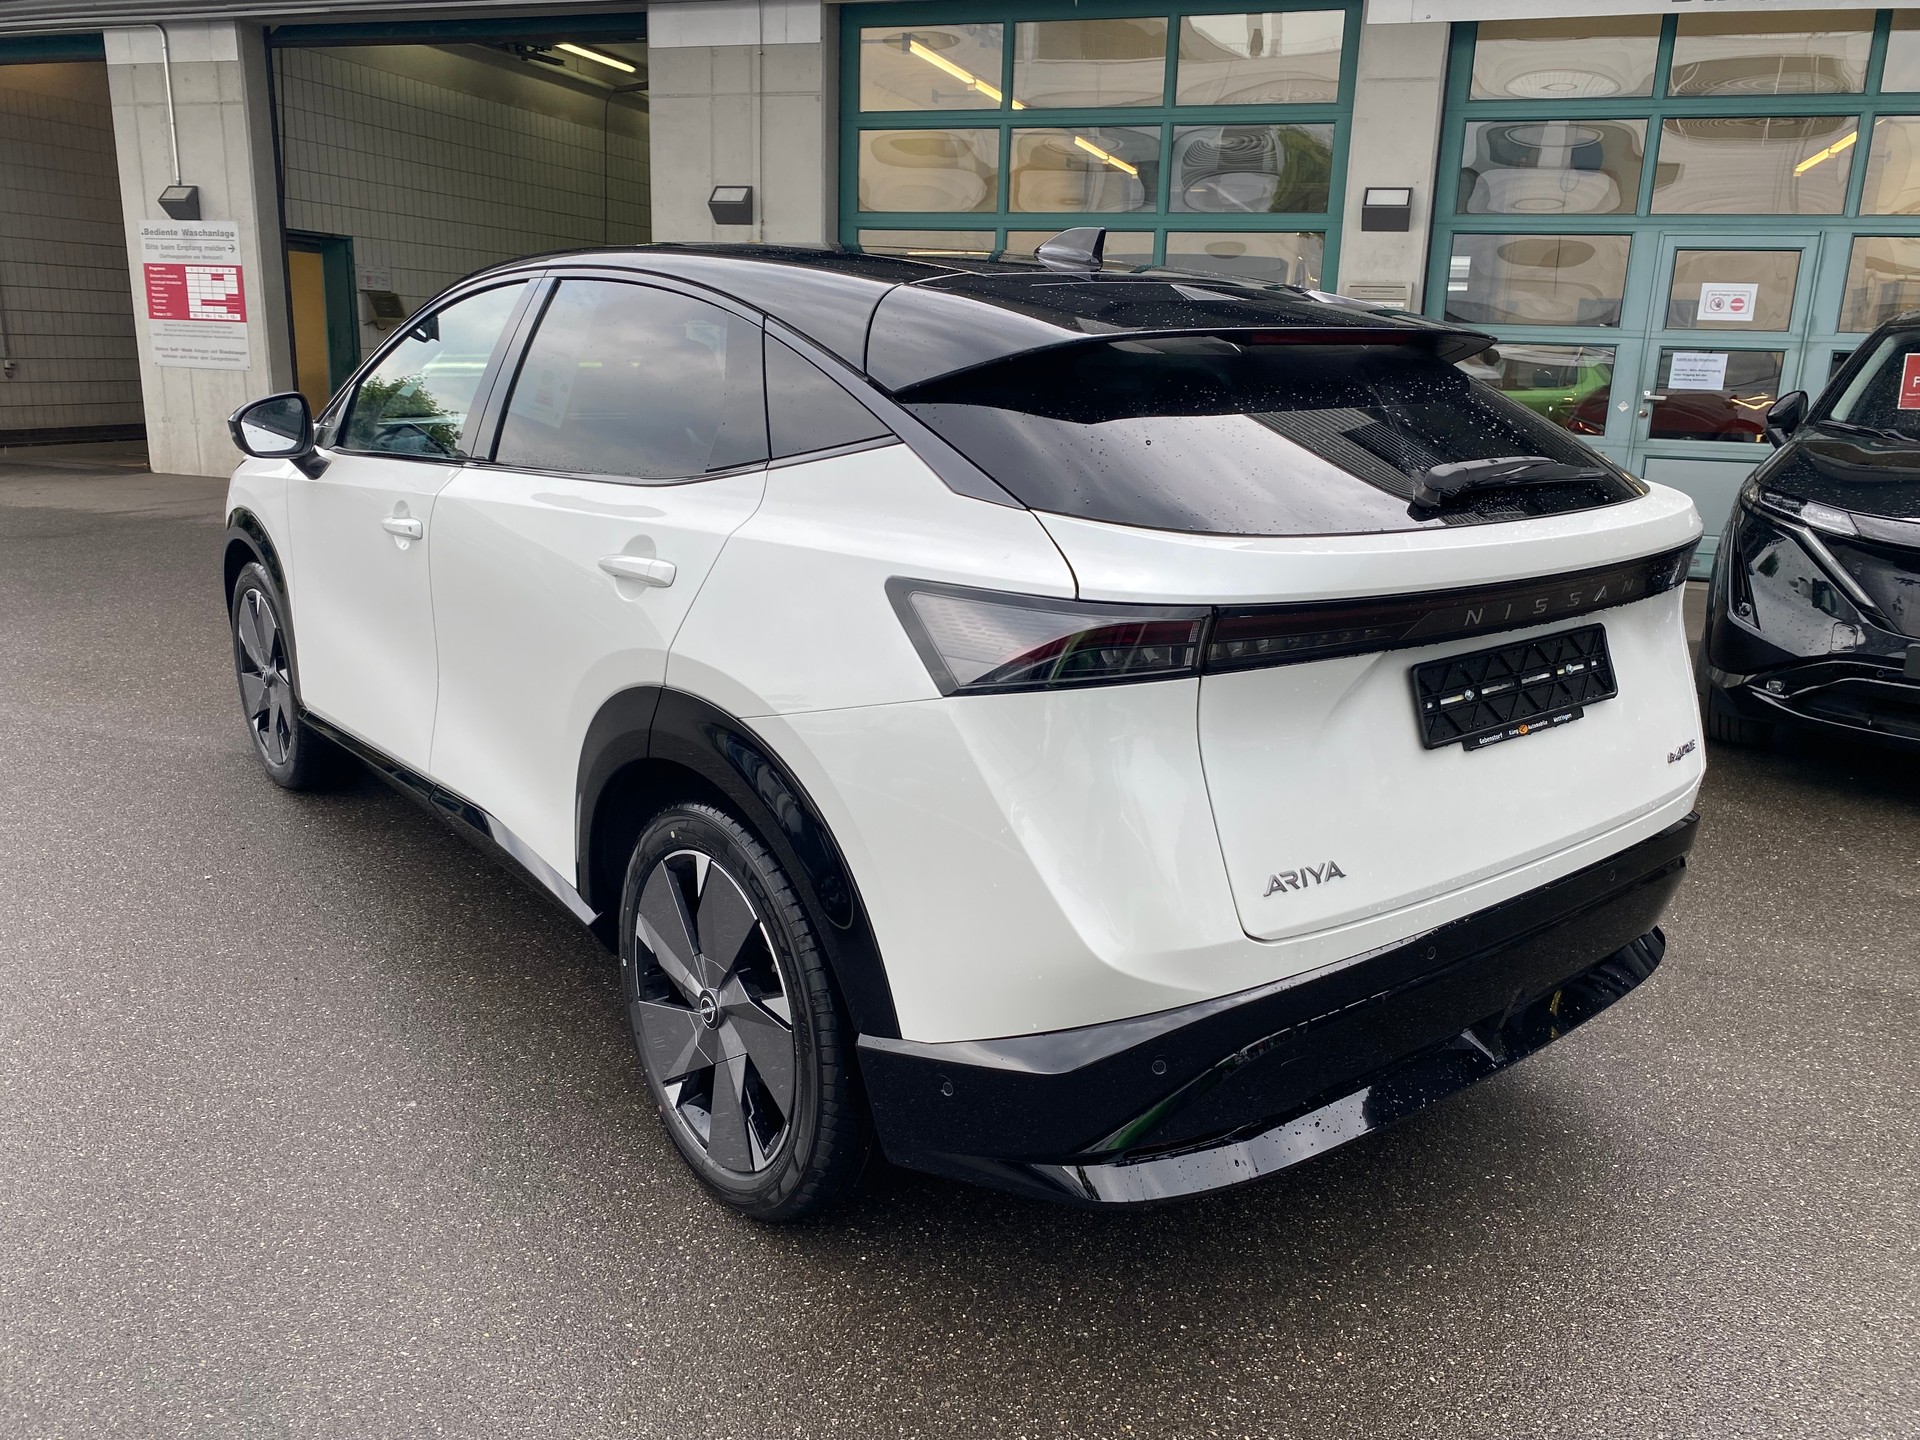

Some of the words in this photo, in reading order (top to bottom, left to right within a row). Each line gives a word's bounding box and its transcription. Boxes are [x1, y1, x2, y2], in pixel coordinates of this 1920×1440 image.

[143, 228, 178, 236] Bediente
[181, 228, 235, 238] Waschanlage
[176, 244, 203, 252] Empfang
[1464, 579, 1634, 626] NISSAN
[1263, 860, 1347, 897] ARIYA
